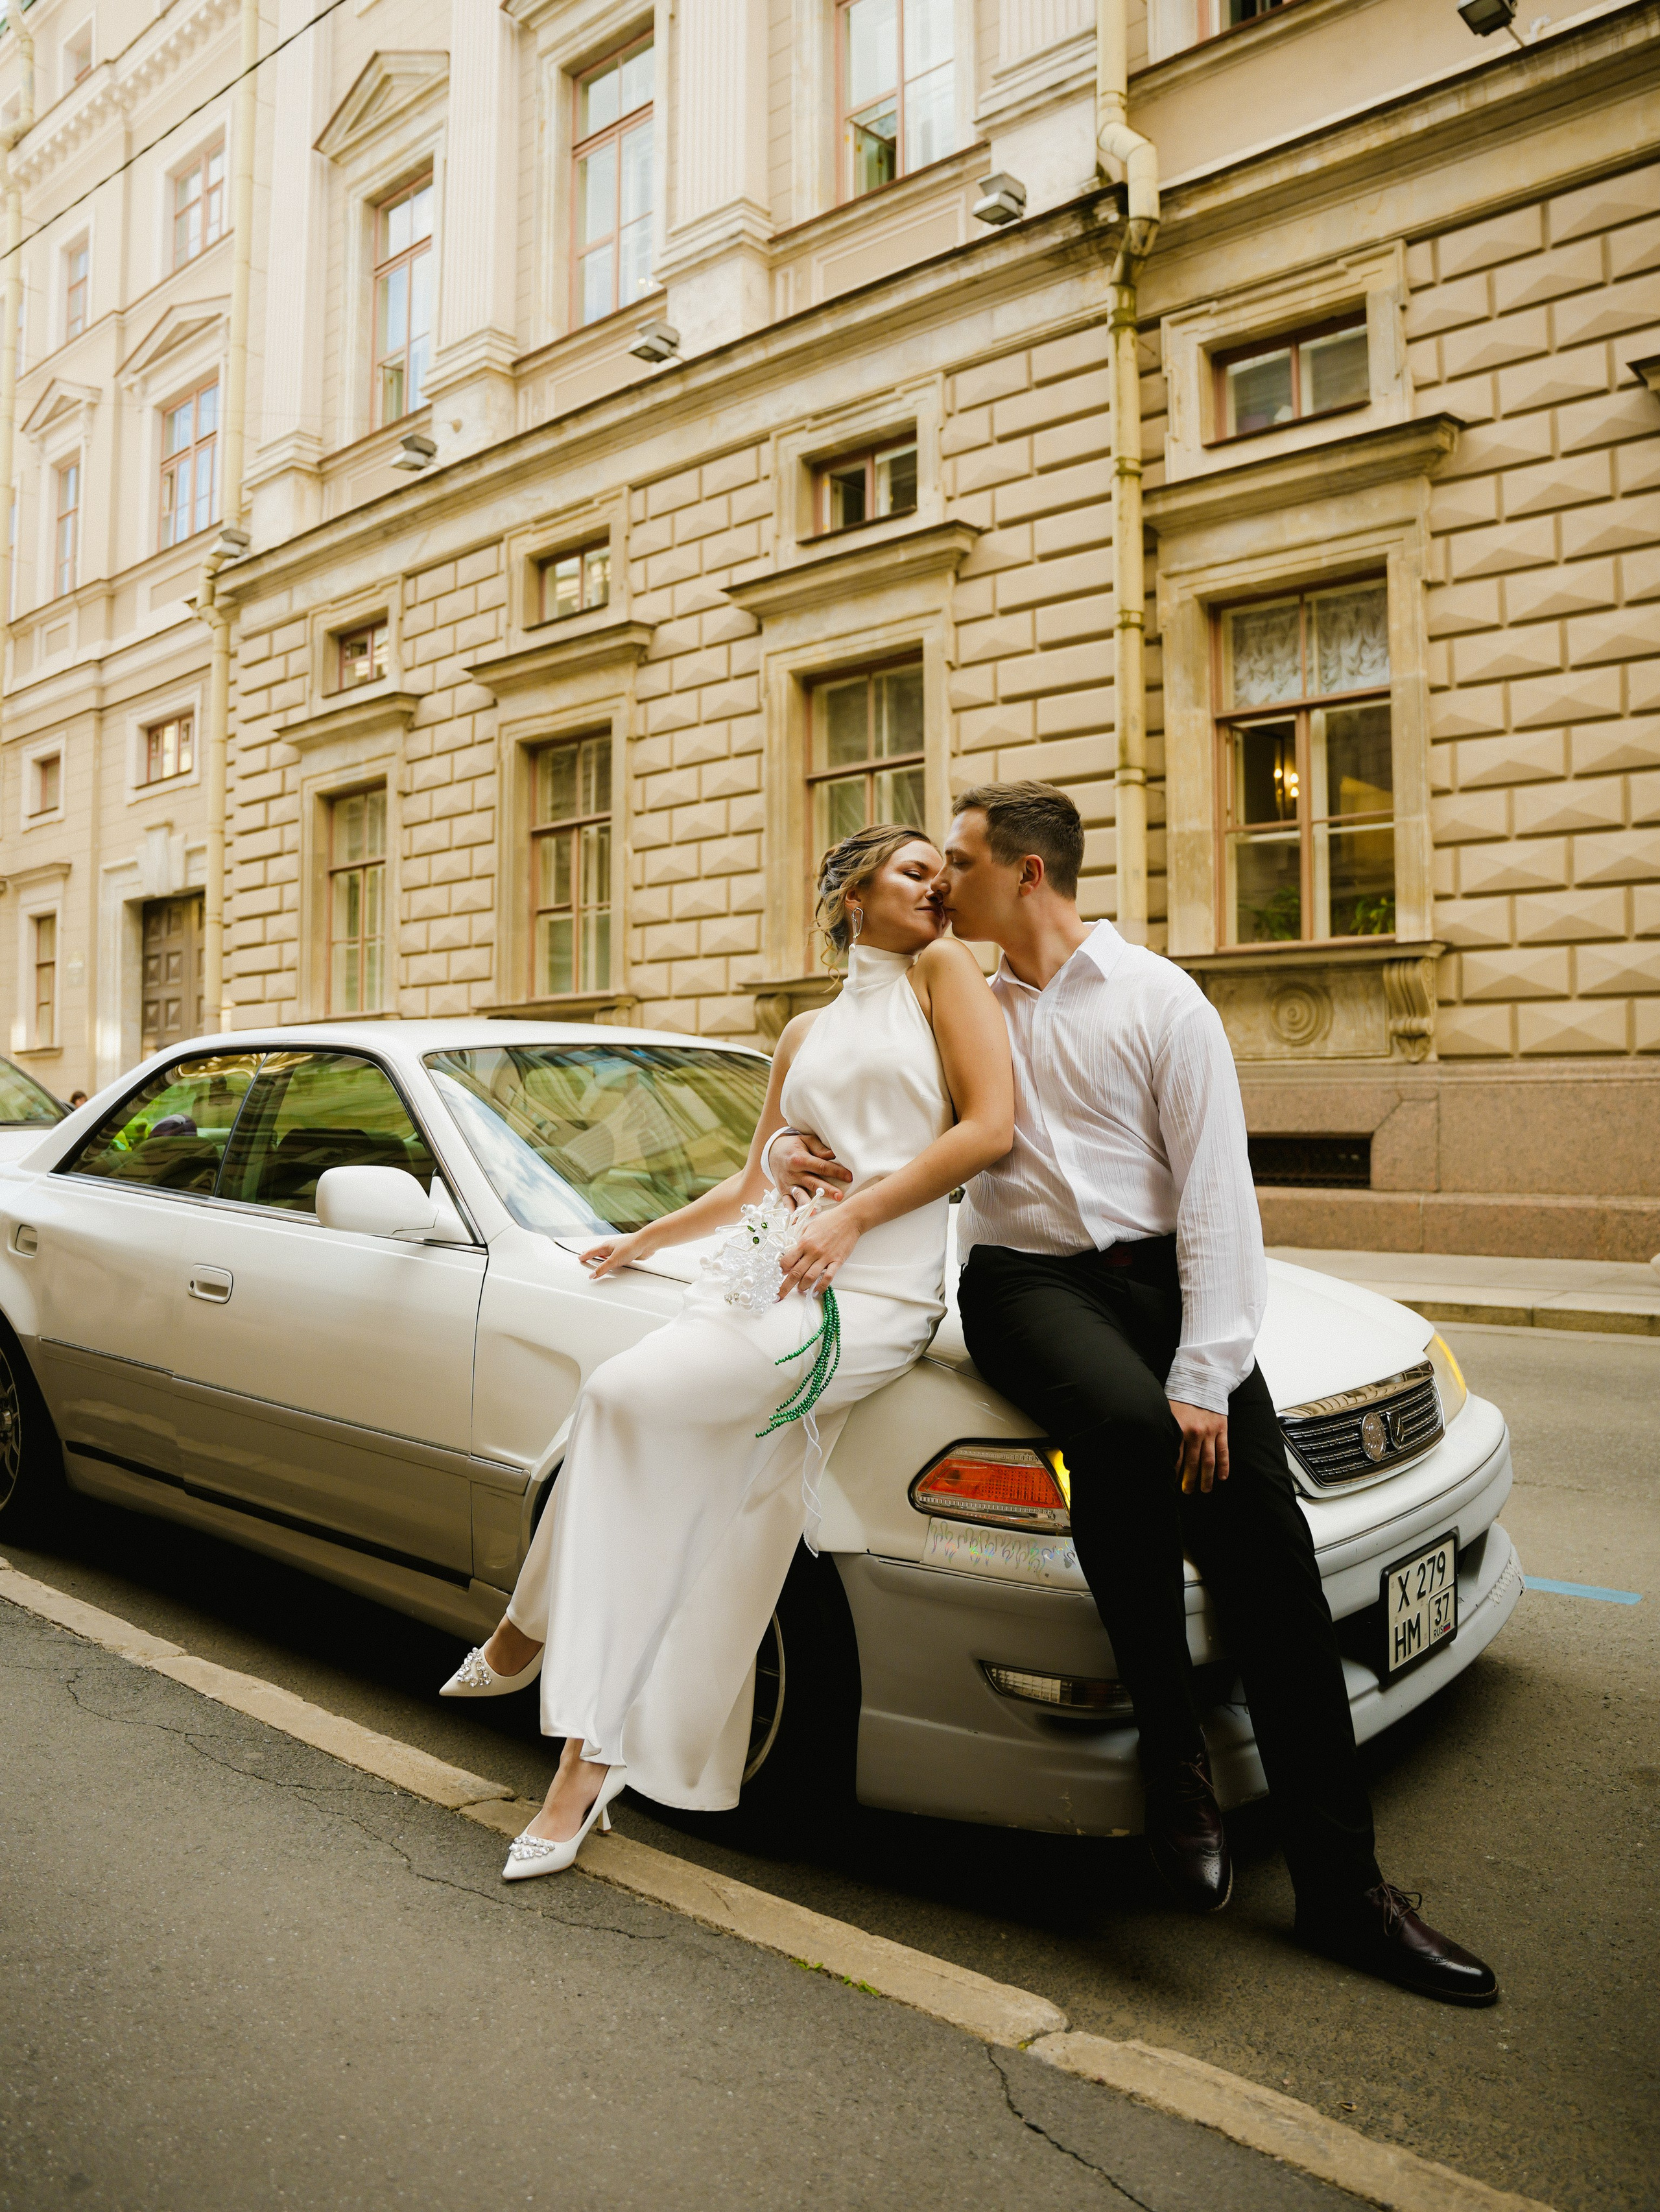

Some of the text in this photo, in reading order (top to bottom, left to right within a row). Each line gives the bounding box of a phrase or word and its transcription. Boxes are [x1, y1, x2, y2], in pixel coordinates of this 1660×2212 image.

[1416, 1550, 1446, 1601] 279
[1434, 1591, 1450, 1626] 37
[1433, 1624, 1443, 1639] RUS
